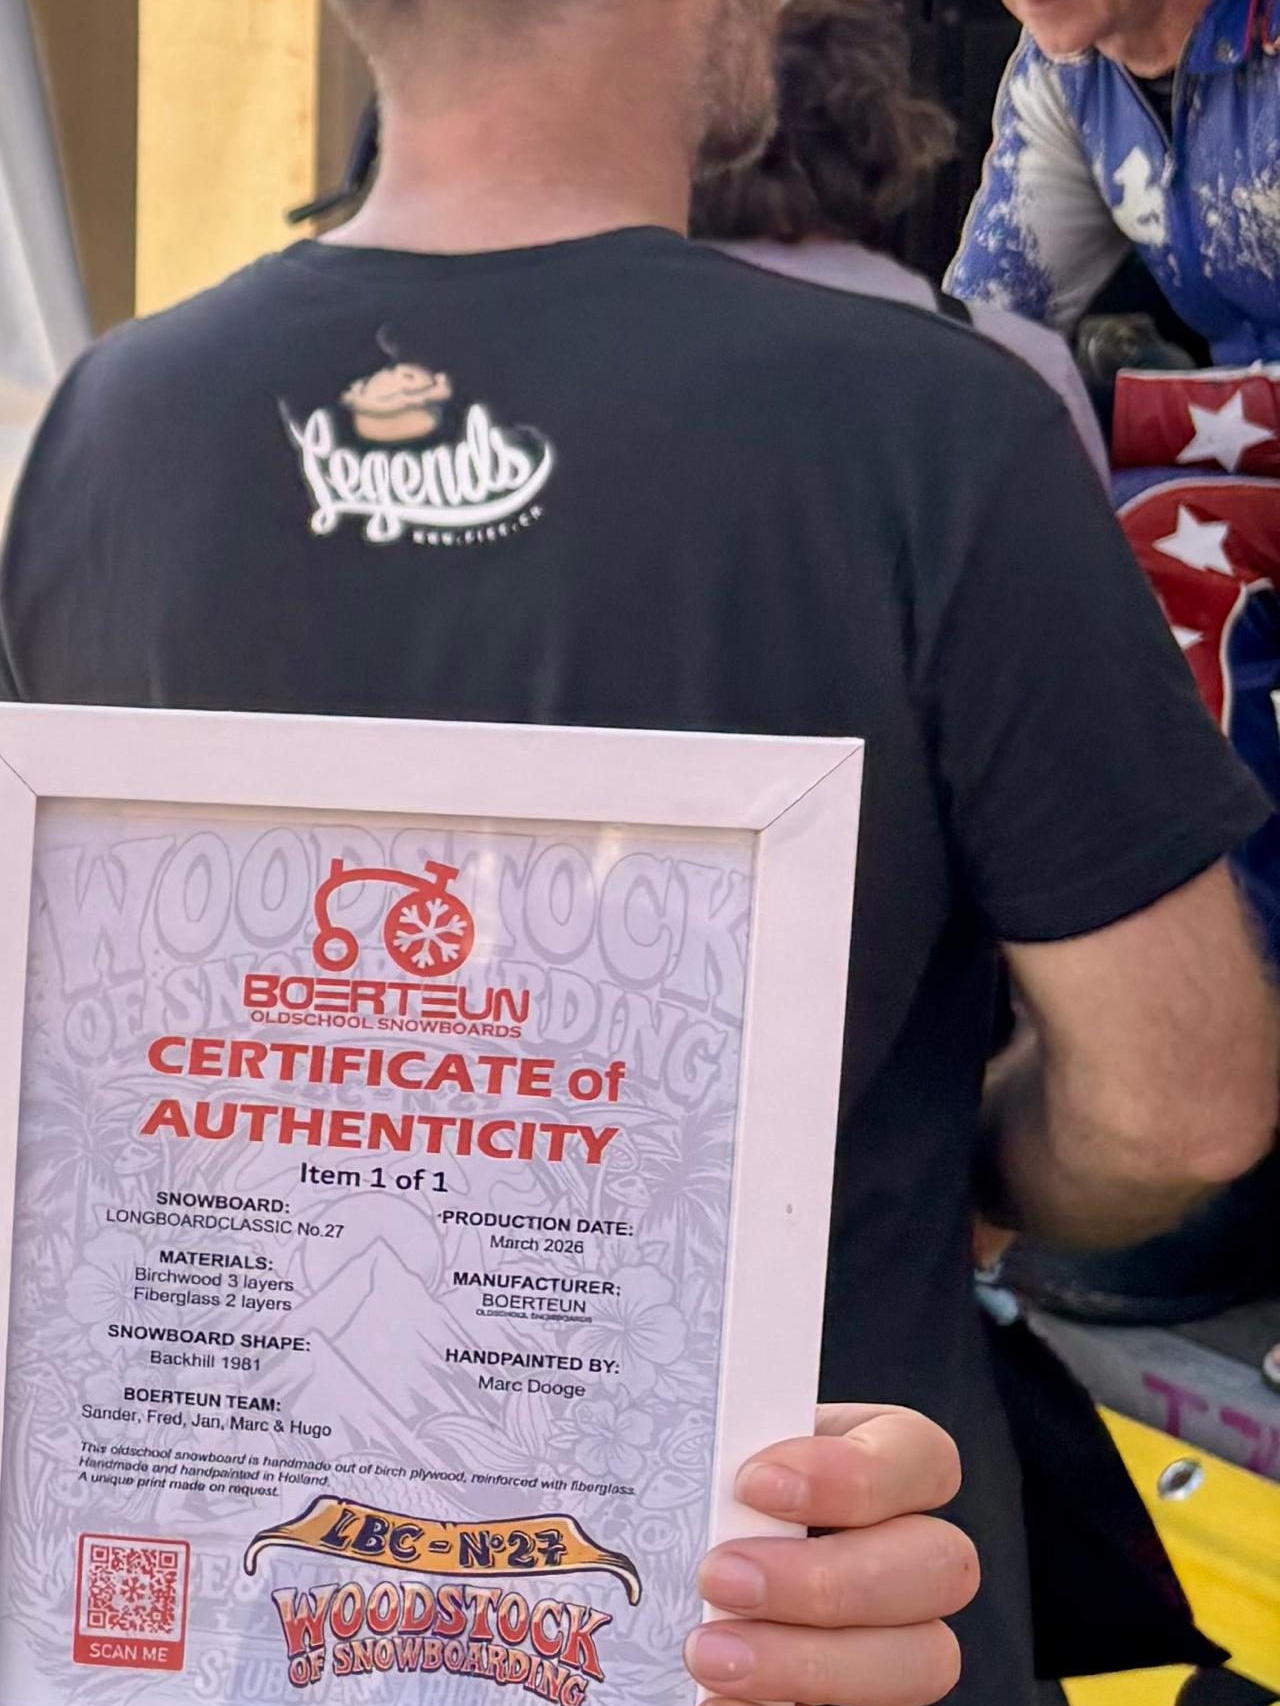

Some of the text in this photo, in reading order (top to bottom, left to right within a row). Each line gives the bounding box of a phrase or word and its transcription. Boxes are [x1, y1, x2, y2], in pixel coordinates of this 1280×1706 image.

[243, 974, 530, 1023] BOERTEUN
[249, 1009, 522, 1038] OLDSCHOOL SNOWBOARDS
[146, 1035, 556, 1099] CERTIFICATE
[567, 1060, 627, 1103] of
[138, 1098, 620, 1165] AUTHENTICITY
[300, 1162, 449, 1193] Item 1 of 1
[155, 1191, 290, 1214] SNOWBOARD:
[106, 1208, 345, 1239] LONGBOARDCLASSIC No.27
[441, 1209, 634, 1237] PRODUCTION DATE:
[490, 1234, 584, 1254] March 2026
[159, 1250, 273, 1271] MATERIALS:
[134, 1267, 295, 1292] Birchwood 3 layers
[452, 1271, 621, 1297] MANUFACTURER:
[133, 1286, 292, 1312] Fiberglass 2 layers
[481, 1293, 587, 1313] BOERTEUN
[107, 1323, 311, 1352] SNOWBOARD SHAPE:
[150, 1350, 261, 1371] Backhill 1981
[444, 1348, 621, 1375] HANDPAINTED BY:
[123, 1387, 281, 1412] BOERTEUN TEAM:
[478, 1375, 587, 1399] Marc Dooge
[81, 1404, 333, 1439] Sander, Fred, Jan, Marc & Hugo
[78, 1456, 149, 1473] Handmade
[151, 1461, 178, 1475] and
[179, 1464, 260, 1482] handpainted
[262, 1470, 275, 1482] in
[80, 1441, 107, 1455] This
[110, 1444, 173, 1460] oldschool
[174, 1449, 247, 1466] snowboard
[248, 1454, 260, 1465] is
[262, 1455, 332, 1472] handmade
[334, 1462, 357, 1475] out
[358, 1463, 374, 1476] of
[374, 1464, 408, 1478] birch
[470, 1472, 539, 1489] reinforced
[541, 1477, 568, 1492] with
[77, 1471, 88, 1482] A
[90, 1473, 134, 1489] unique
[135, 1476, 167, 1491] print
[168, 1478, 206, 1492] made
[208, 1482, 226, 1493] on
[318, 1508, 420, 1560] LBC
[271, 1579, 614, 1684] WOODSTOCK
[88, 1643, 170, 1663] SCAN ME
[287, 1651, 327, 1690] OF
